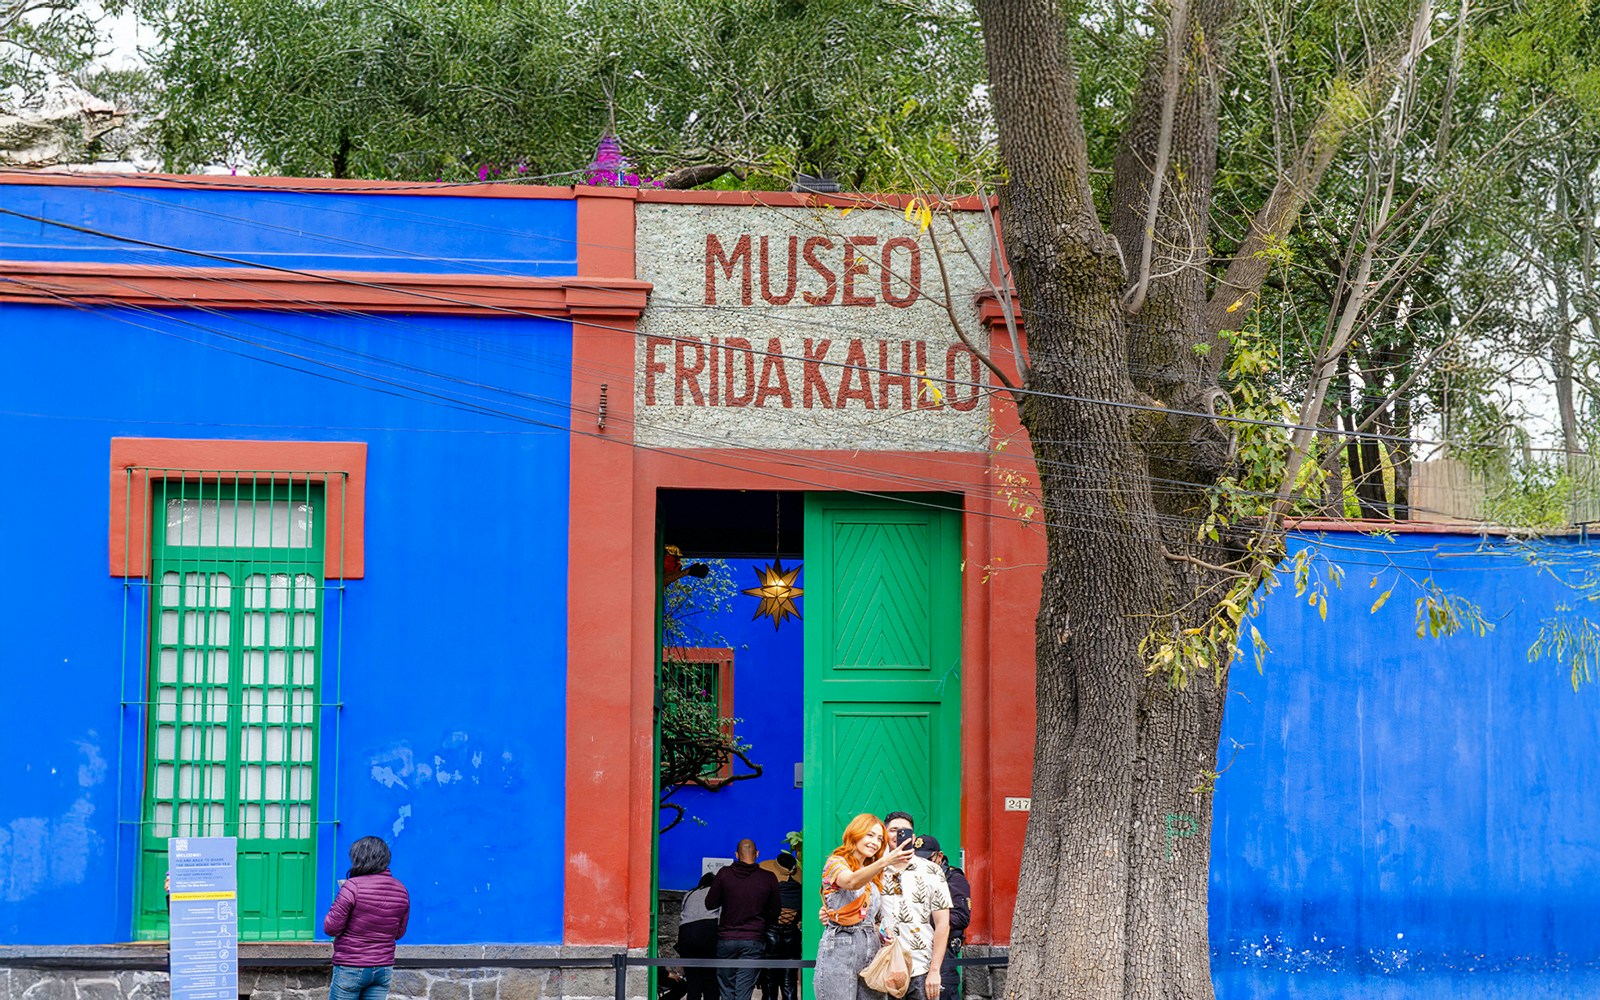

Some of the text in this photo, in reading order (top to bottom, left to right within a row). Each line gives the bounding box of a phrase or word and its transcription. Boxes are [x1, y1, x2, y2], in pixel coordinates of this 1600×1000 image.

[704, 233, 921, 308] MUSEO
[645, 336, 980, 411] FRIDA KAHLO
[1008, 799, 1029, 809] 247
